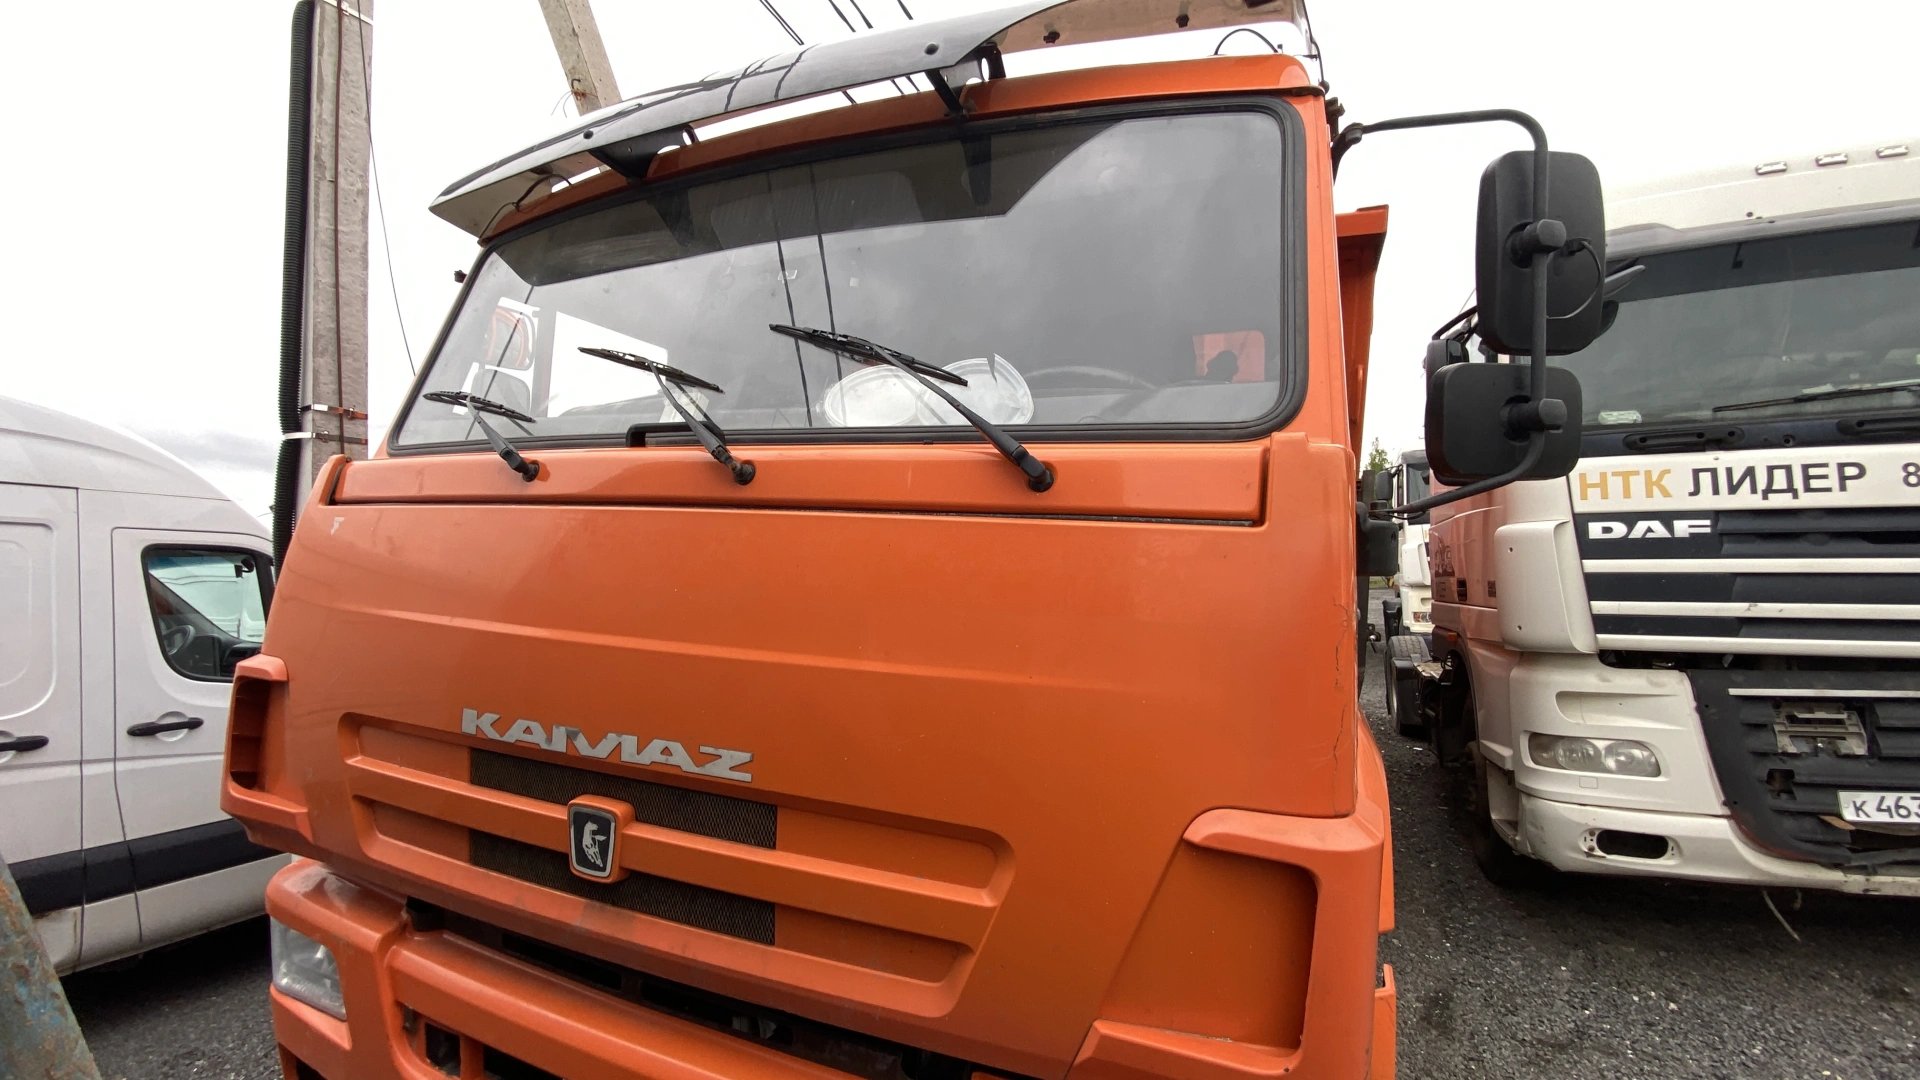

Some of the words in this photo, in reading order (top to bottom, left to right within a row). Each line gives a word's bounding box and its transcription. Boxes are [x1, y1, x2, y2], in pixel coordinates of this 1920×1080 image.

[1579, 469, 1673, 500] НТК
[1688, 462, 1867, 500] ЛИДЕР
[1588, 519, 1712, 539] DAF
[461, 708, 752, 782] KAMAZ
